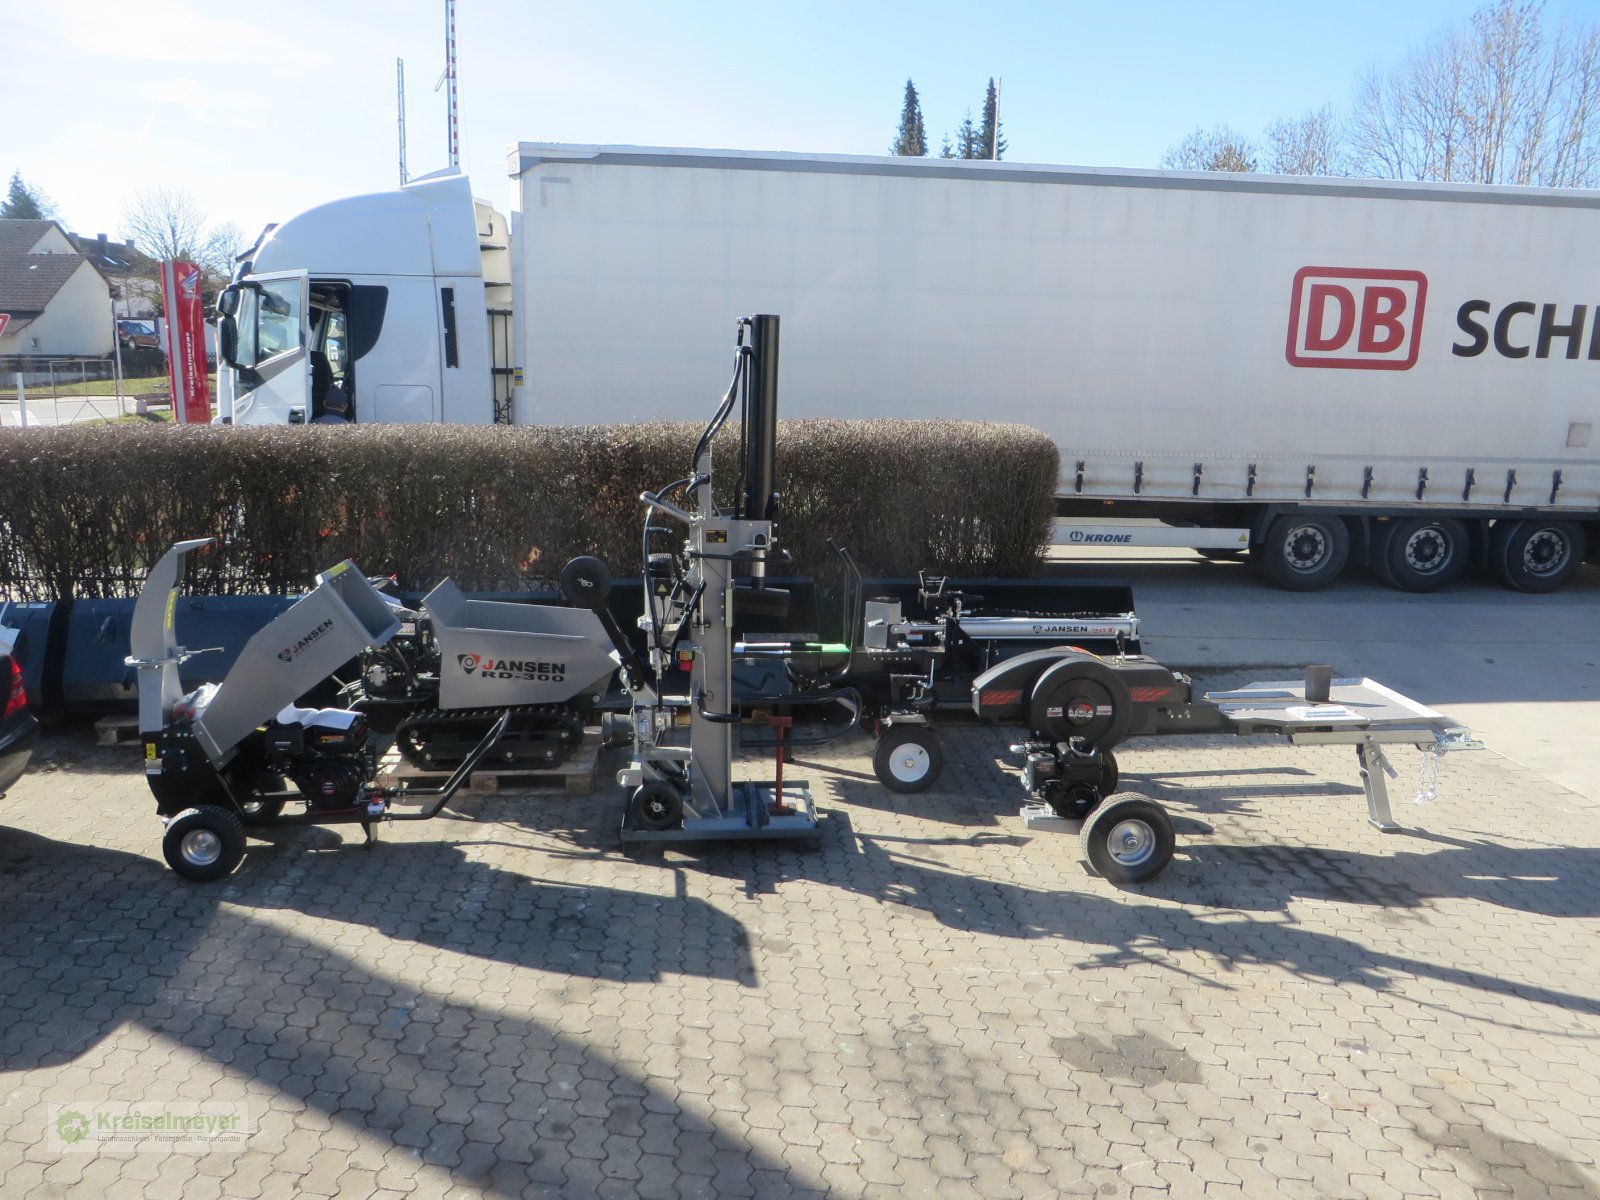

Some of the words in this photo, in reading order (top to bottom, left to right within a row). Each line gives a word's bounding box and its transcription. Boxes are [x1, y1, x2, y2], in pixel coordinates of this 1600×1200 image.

[1304, 283, 1408, 353] DB
[1084, 533, 1132, 543] KRONE
[293, 619, 334, 653] JANSEN
[482, 659, 566, 675] JANSEN
[481, 671, 565, 682] RD-300
